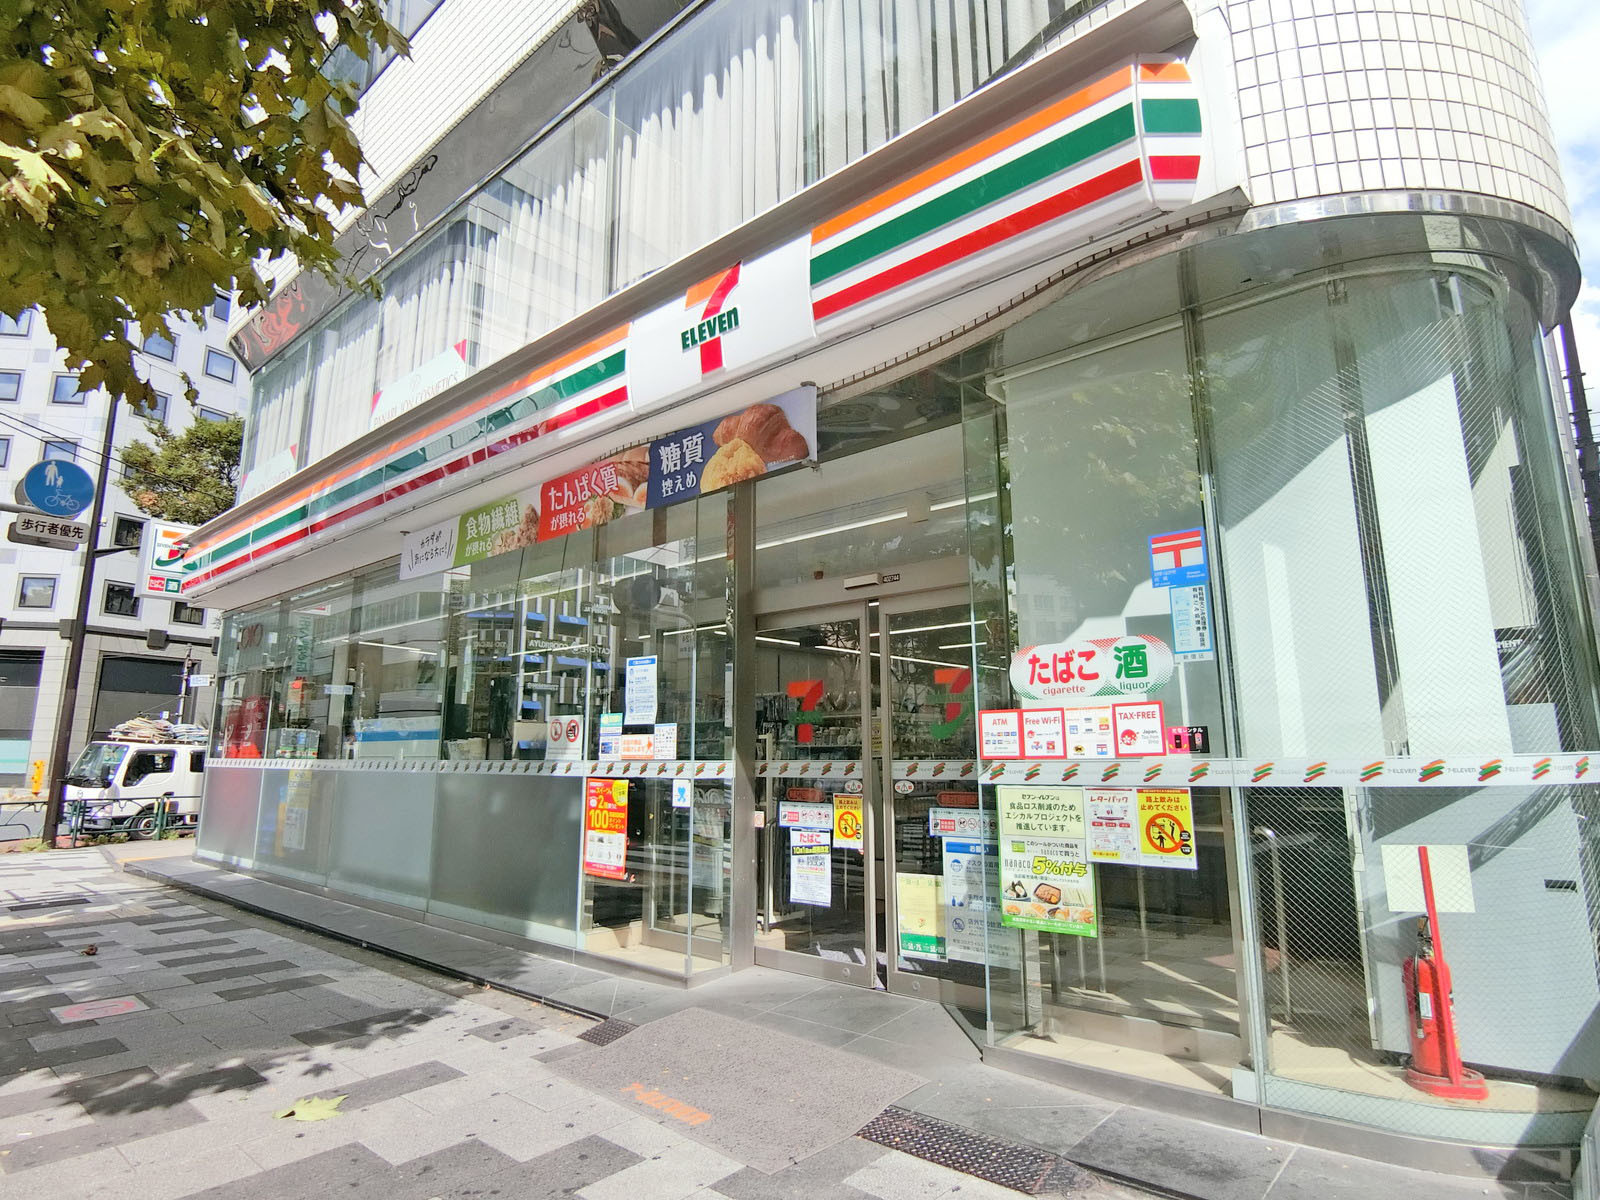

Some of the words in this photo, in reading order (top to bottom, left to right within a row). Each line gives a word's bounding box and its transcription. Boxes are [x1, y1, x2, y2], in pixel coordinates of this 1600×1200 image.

[659, 433, 705, 476] 糖質
[548, 464, 620, 511] たんぱく質
[661, 472, 698, 498] 控えめ
[465, 499, 521, 541] 食物繊維
[550, 508, 586, 532] が摂れる
[21, 518, 85, 539] 歩行者優先
[464, 538, 494, 557] が摂れる
[1028, 649, 1100, 686] たばこ
[1113, 643, 1149, 680] 酒
[1042, 685, 1087, 697] cigarette
[1119, 681, 1151, 692] liquor
[991, 717, 1008, 726] ATM
[1025, 716, 1041, 726] Free
[1041, 715, 1061, 726] Wi-Fi
[1118, 710, 1157, 721] TAX-FREE
[1090, 795, 1129, 803] レターパック
[1009, 802, 1077, 812] 食品ロス削減のため
[1140, 804, 1188, 812] 止めてください
[589, 809, 609, 829] 100
[1004, 813, 1083, 823] エシカルプロジェクトを
[1015, 822, 1072, 833] 推進しています。
[799, 833, 822, 844] たばこ
[1026, 840, 1079, 849] このシールがついた商品を
[1004, 858, 1032, 869] nanaco
[1032, 856, 1088, 877] 5%付与
